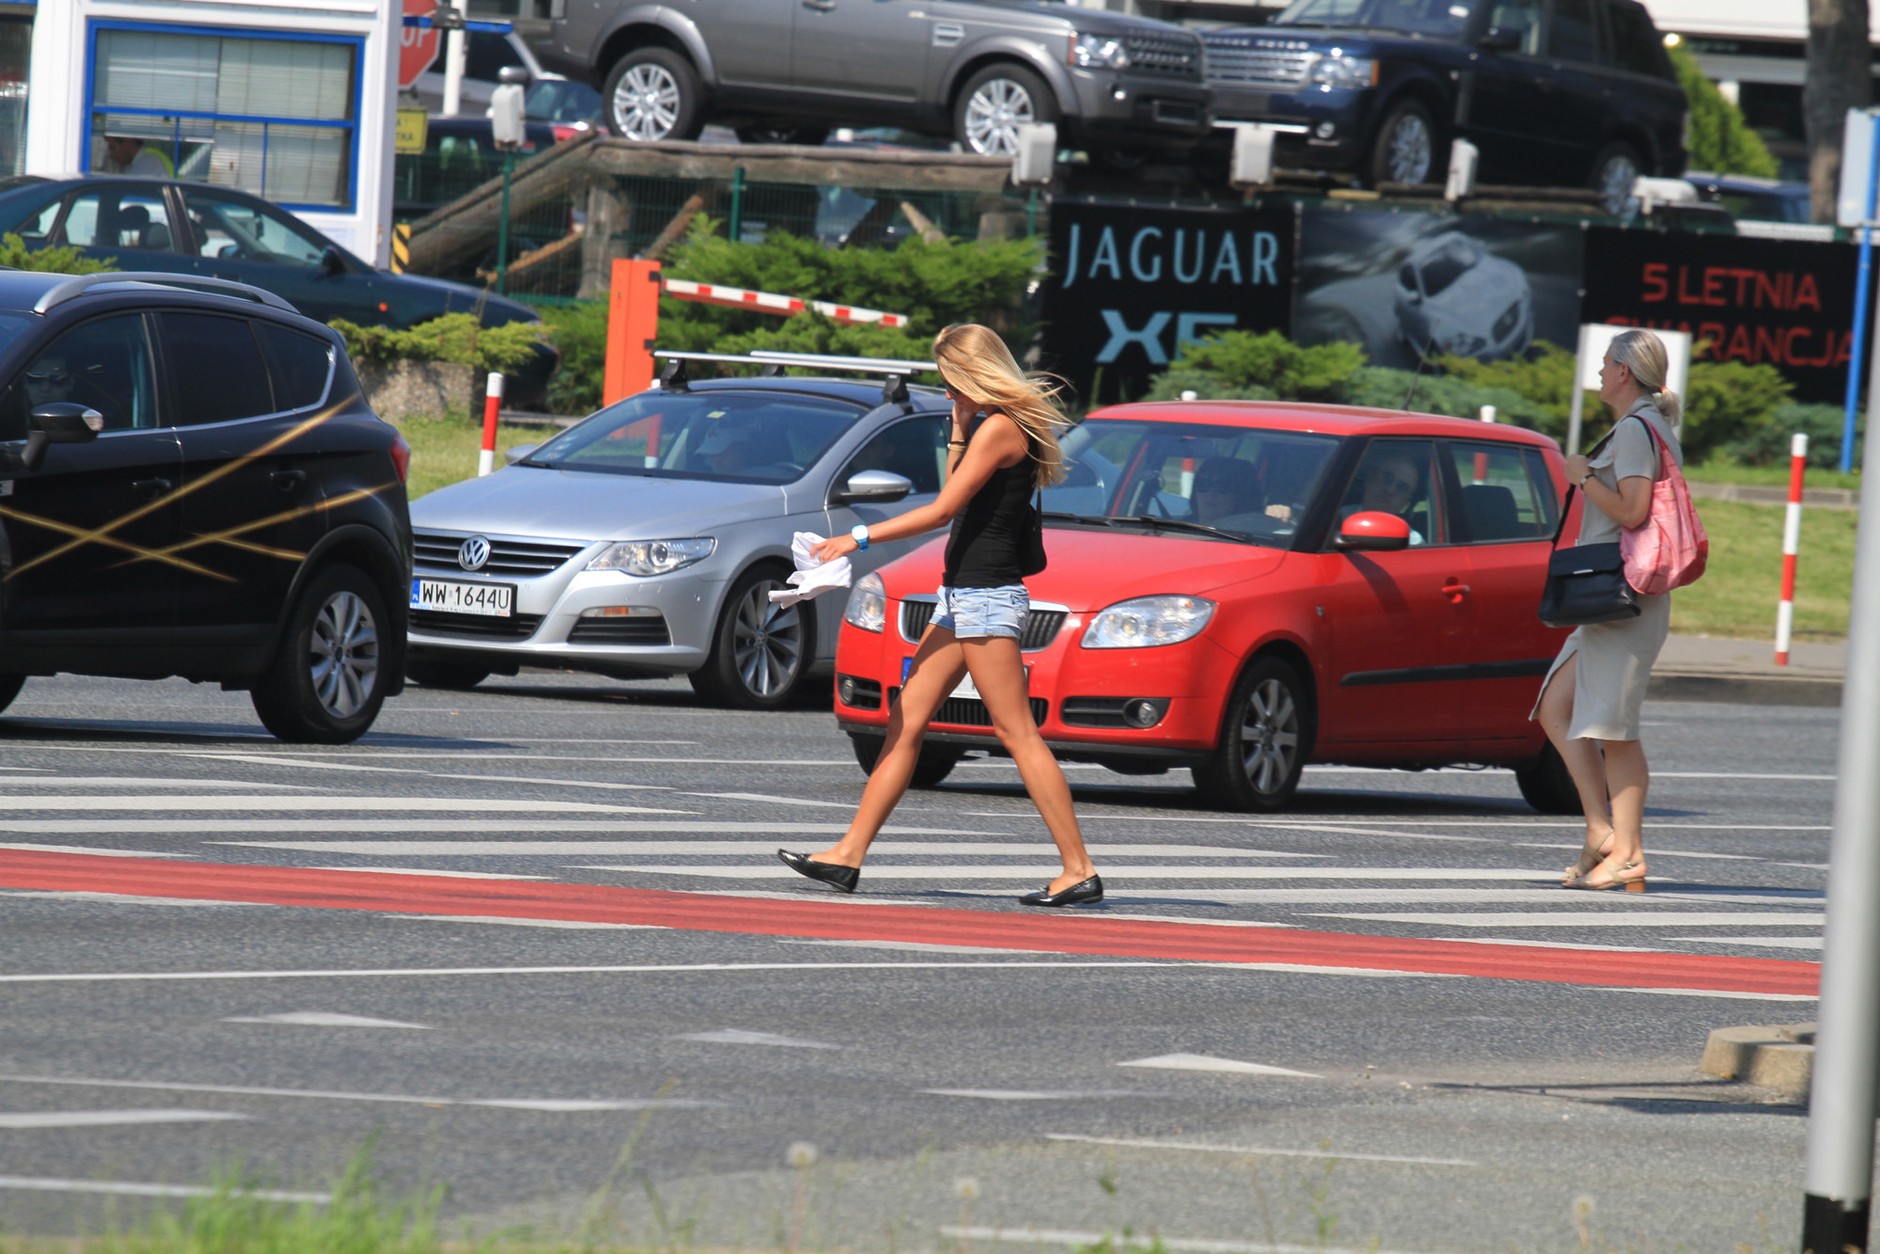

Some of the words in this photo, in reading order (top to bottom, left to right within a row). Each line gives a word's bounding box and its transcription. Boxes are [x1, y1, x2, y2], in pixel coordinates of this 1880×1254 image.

[1062, 223, 1279, 288] JAGUAR
[1642, 263, 1669, 301] 5
[1677, 265, 1821, 311] LETNIA
[423, 583, 447, 604] WW
[455, 586, 509, 609] 1644U
